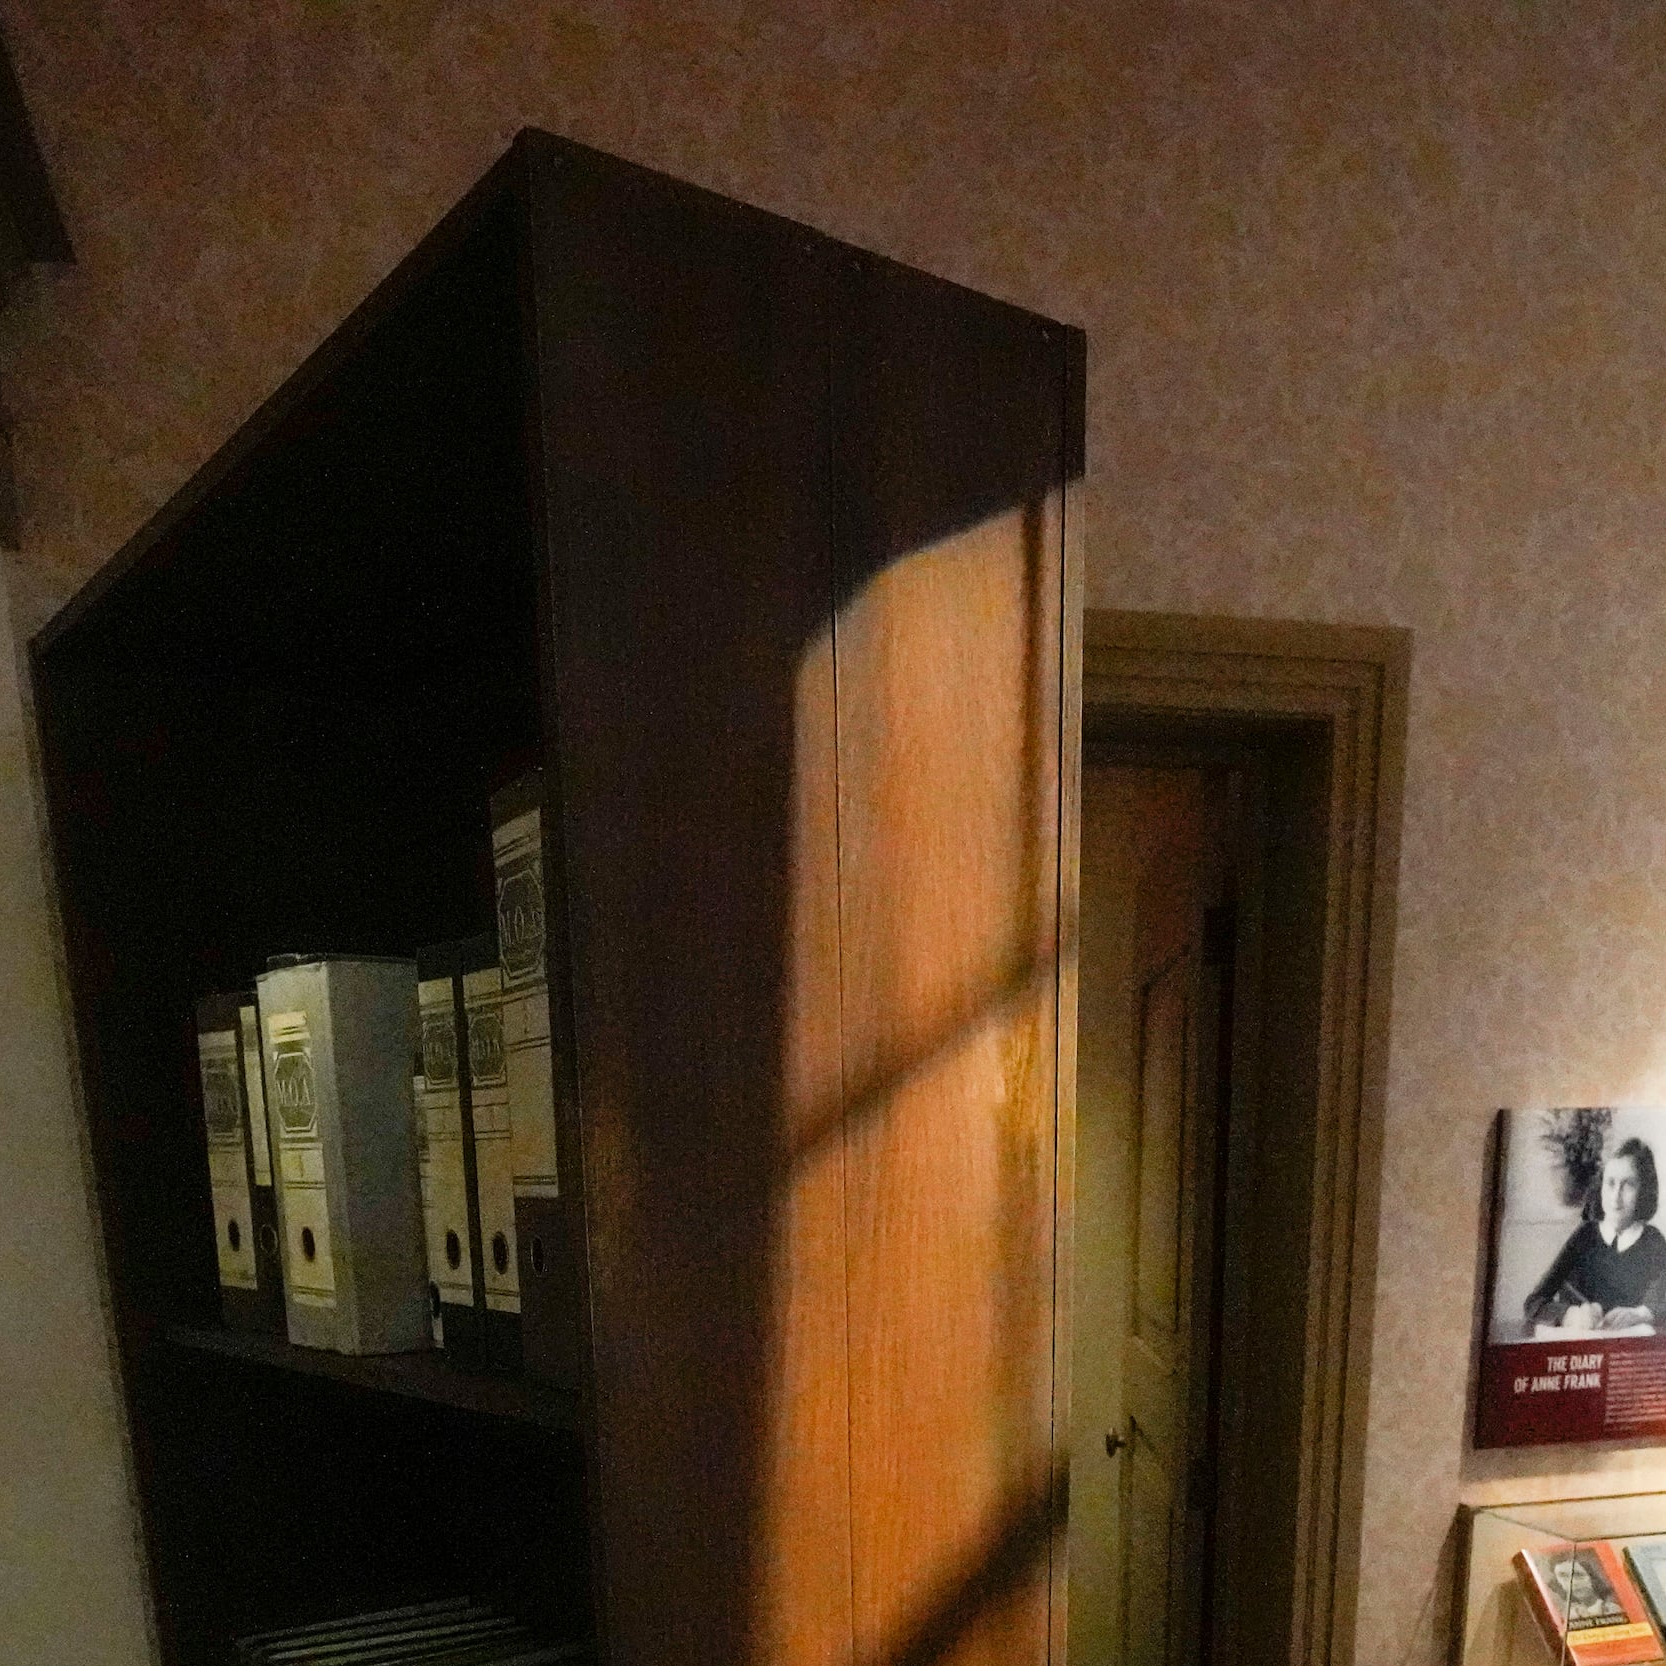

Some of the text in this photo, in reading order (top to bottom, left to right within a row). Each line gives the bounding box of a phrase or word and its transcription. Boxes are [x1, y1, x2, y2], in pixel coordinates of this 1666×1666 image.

[1547, 1354, 1604, 1372] THE DIARY
[1514, 1373, 1601, 1394] OF ANNE FRANK
